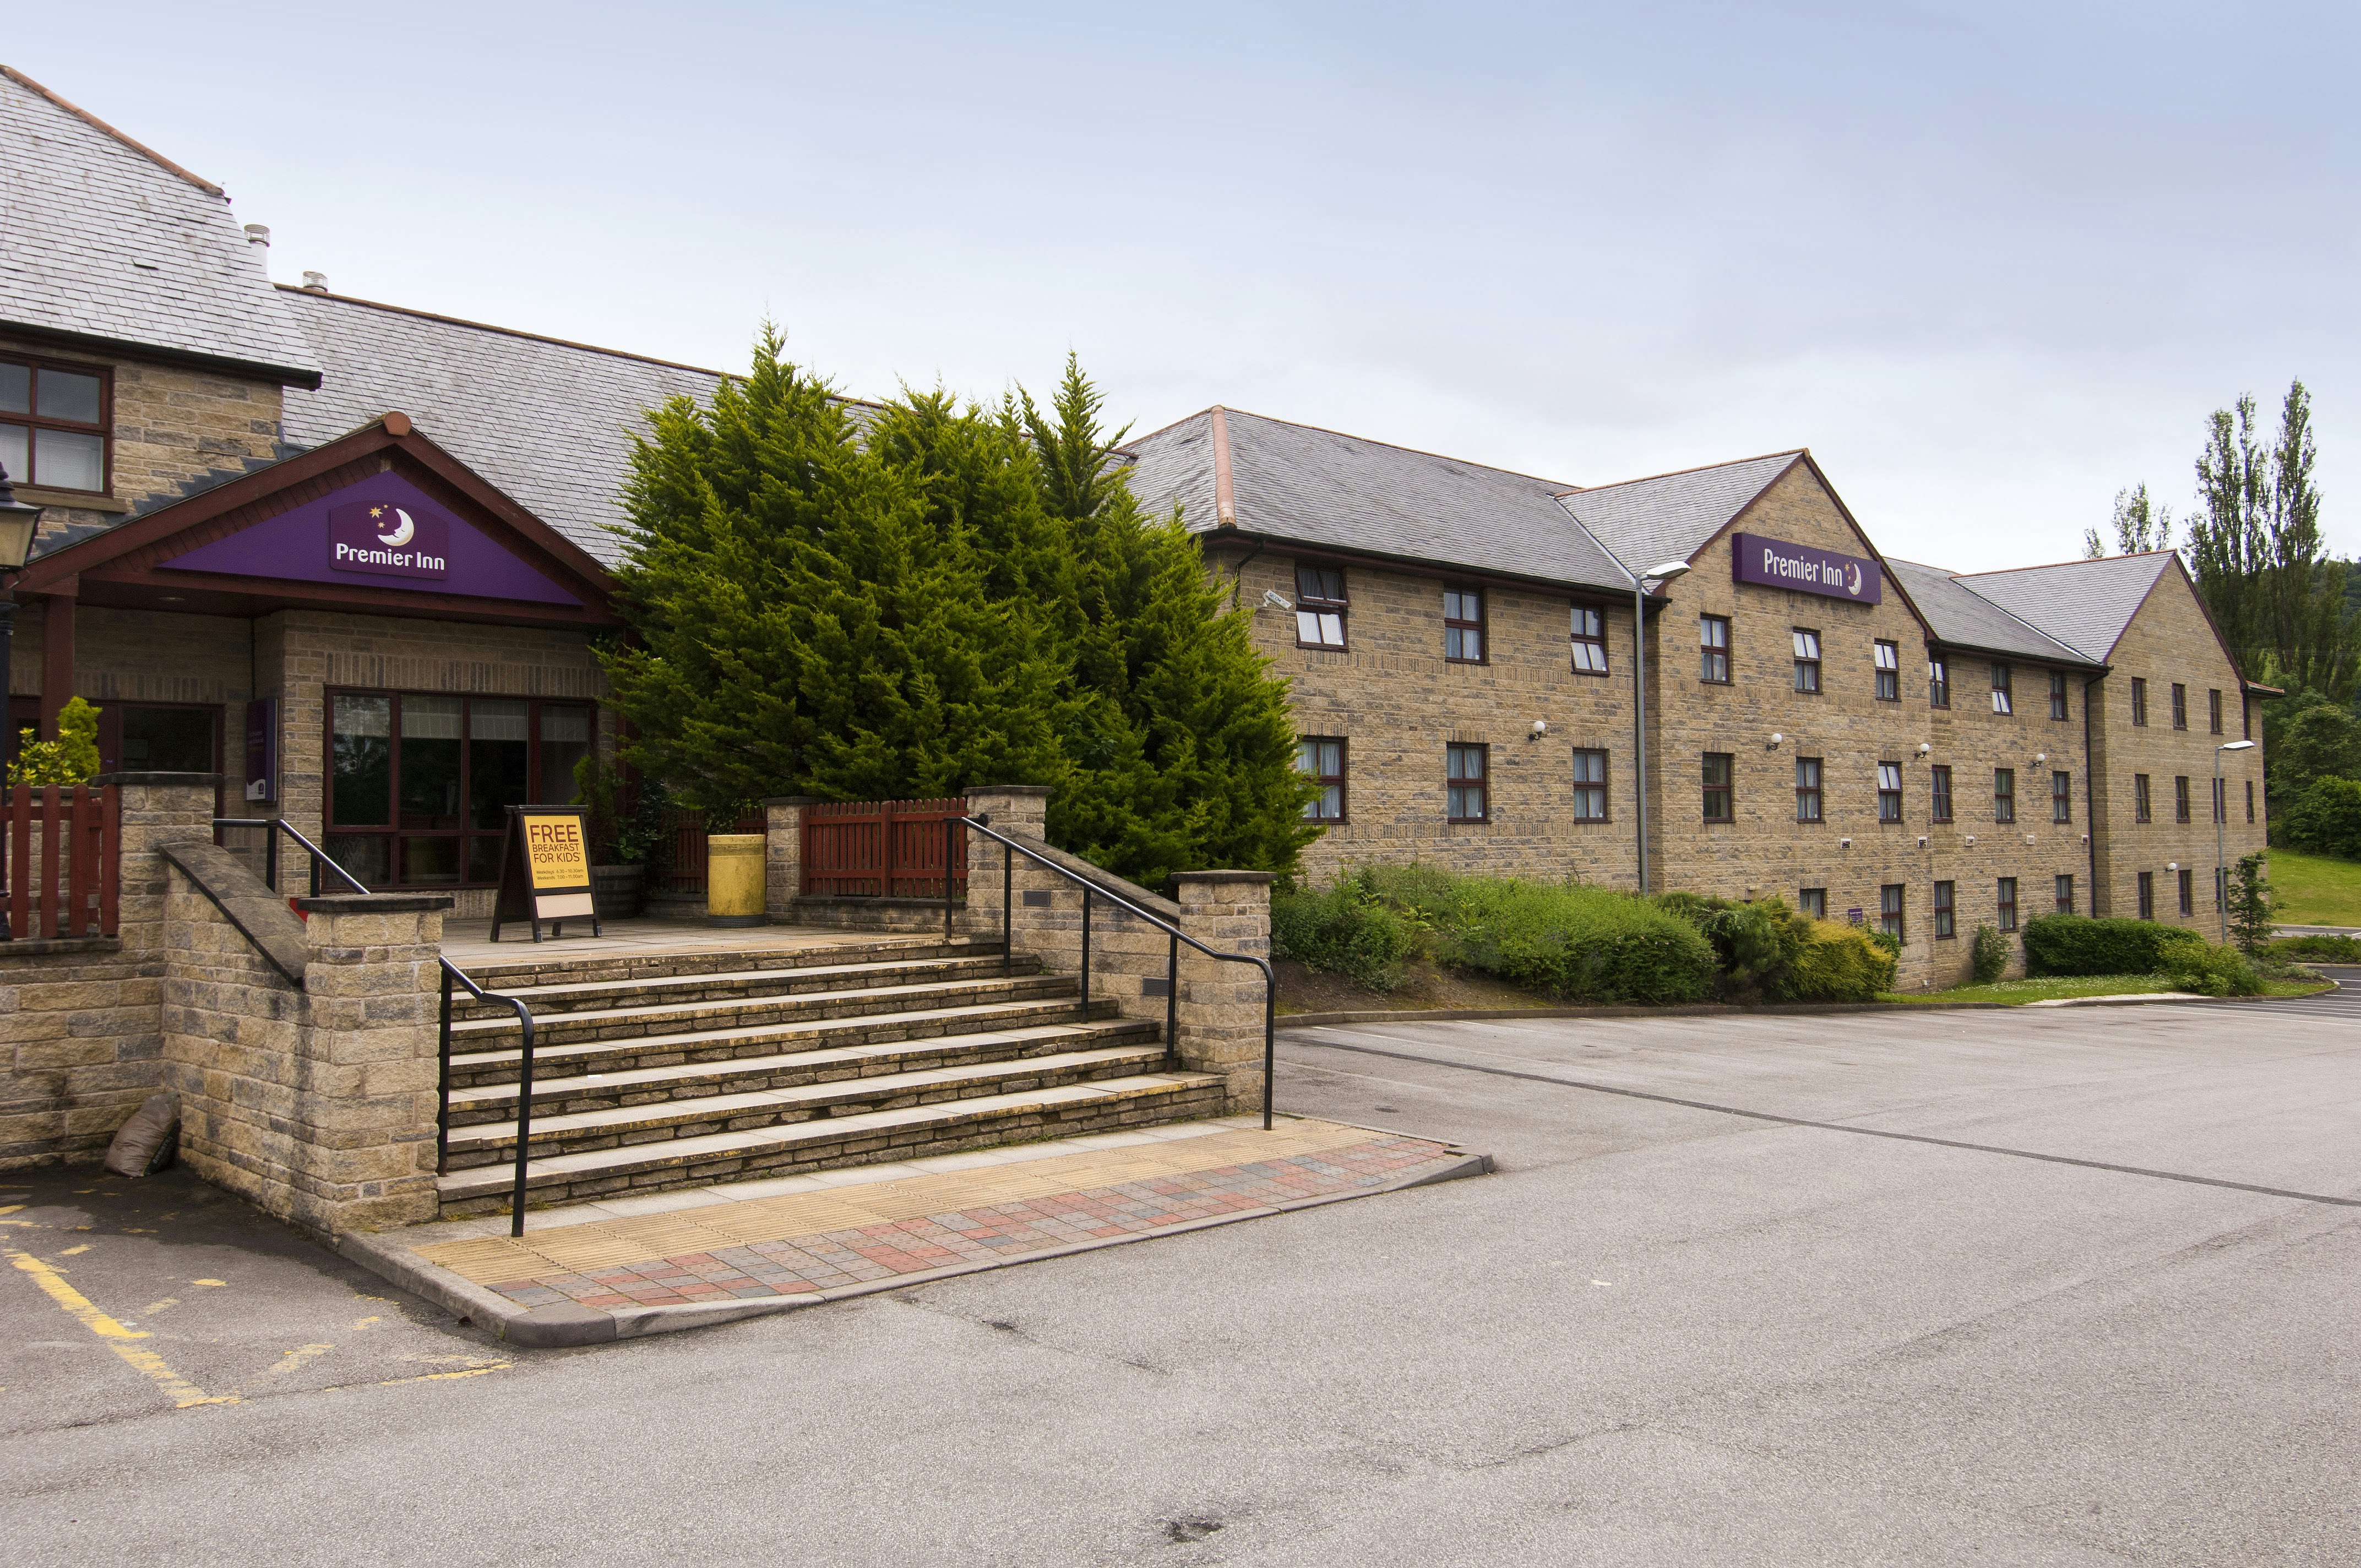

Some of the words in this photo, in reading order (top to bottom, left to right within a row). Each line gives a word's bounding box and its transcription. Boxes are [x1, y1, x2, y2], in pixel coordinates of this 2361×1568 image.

[336, 543, 413, 567] Premier
[417, 552, 444, 570] Inn
[1764, 548, 1819, 581] Premier
[1823, 560, 1842, 587] Inn
[530, 824, 579, 843] FREE
[532, 843, 579, 852] BREAKFAST
[534, 853, 554, 863] FOR
